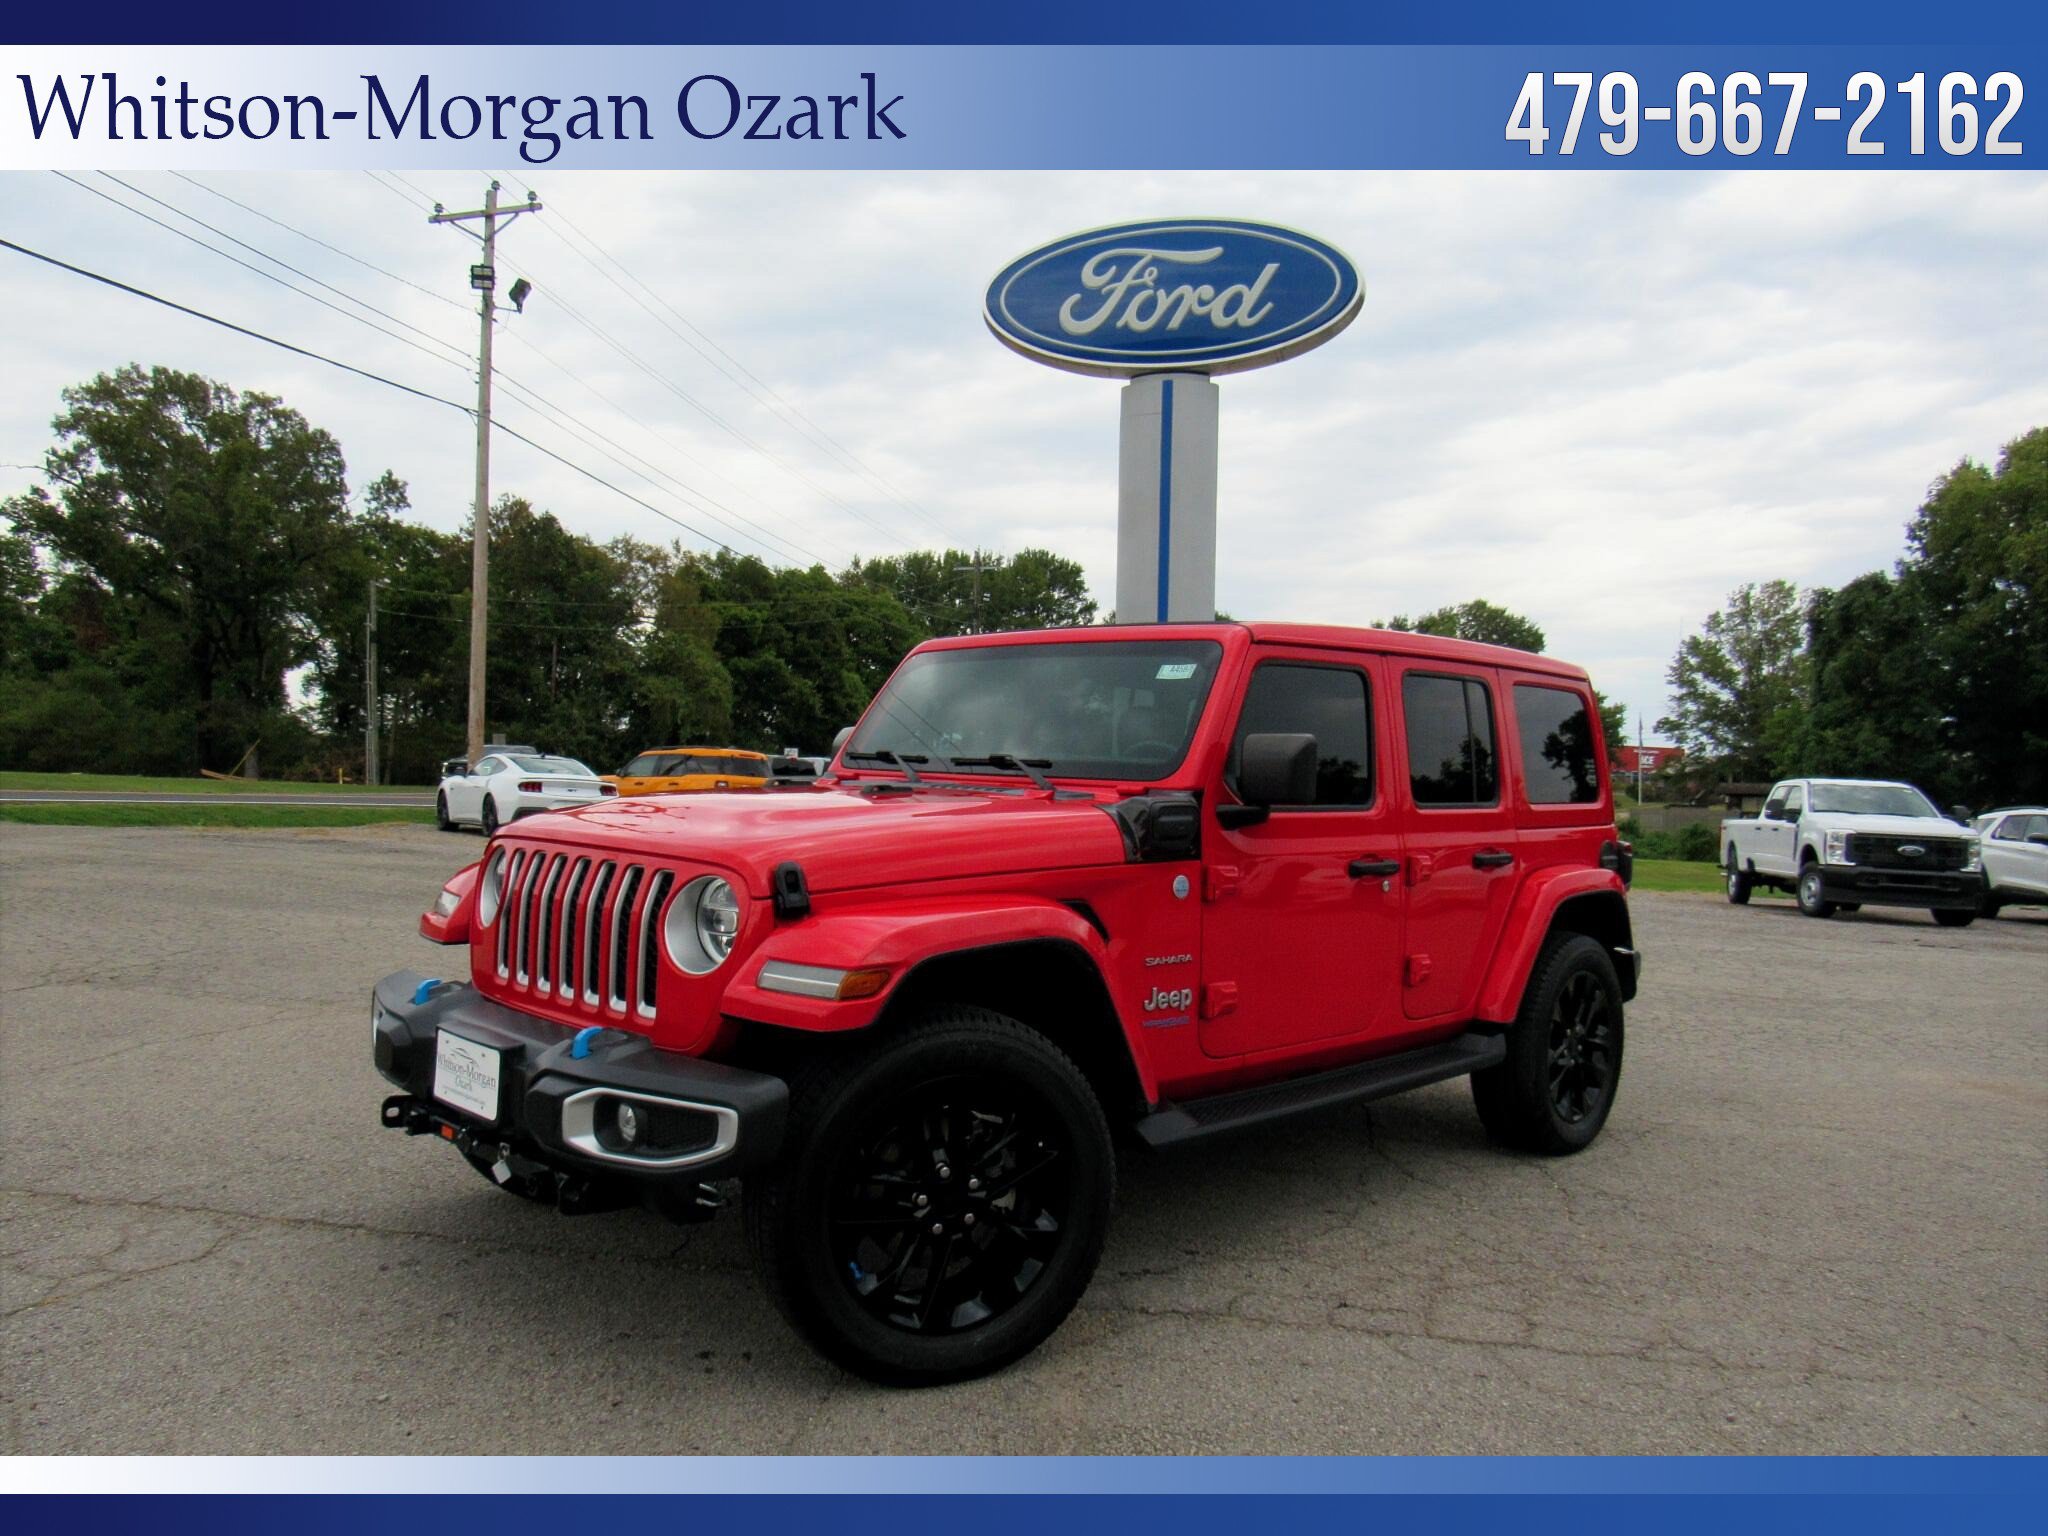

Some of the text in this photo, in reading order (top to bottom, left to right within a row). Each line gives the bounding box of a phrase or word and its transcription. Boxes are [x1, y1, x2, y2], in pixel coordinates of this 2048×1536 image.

[1058, 246, 1280, 336] Ford
[1145, 954, 1193, 967] SAHARA
[1144, 987, 1193, 1012] Jeep
